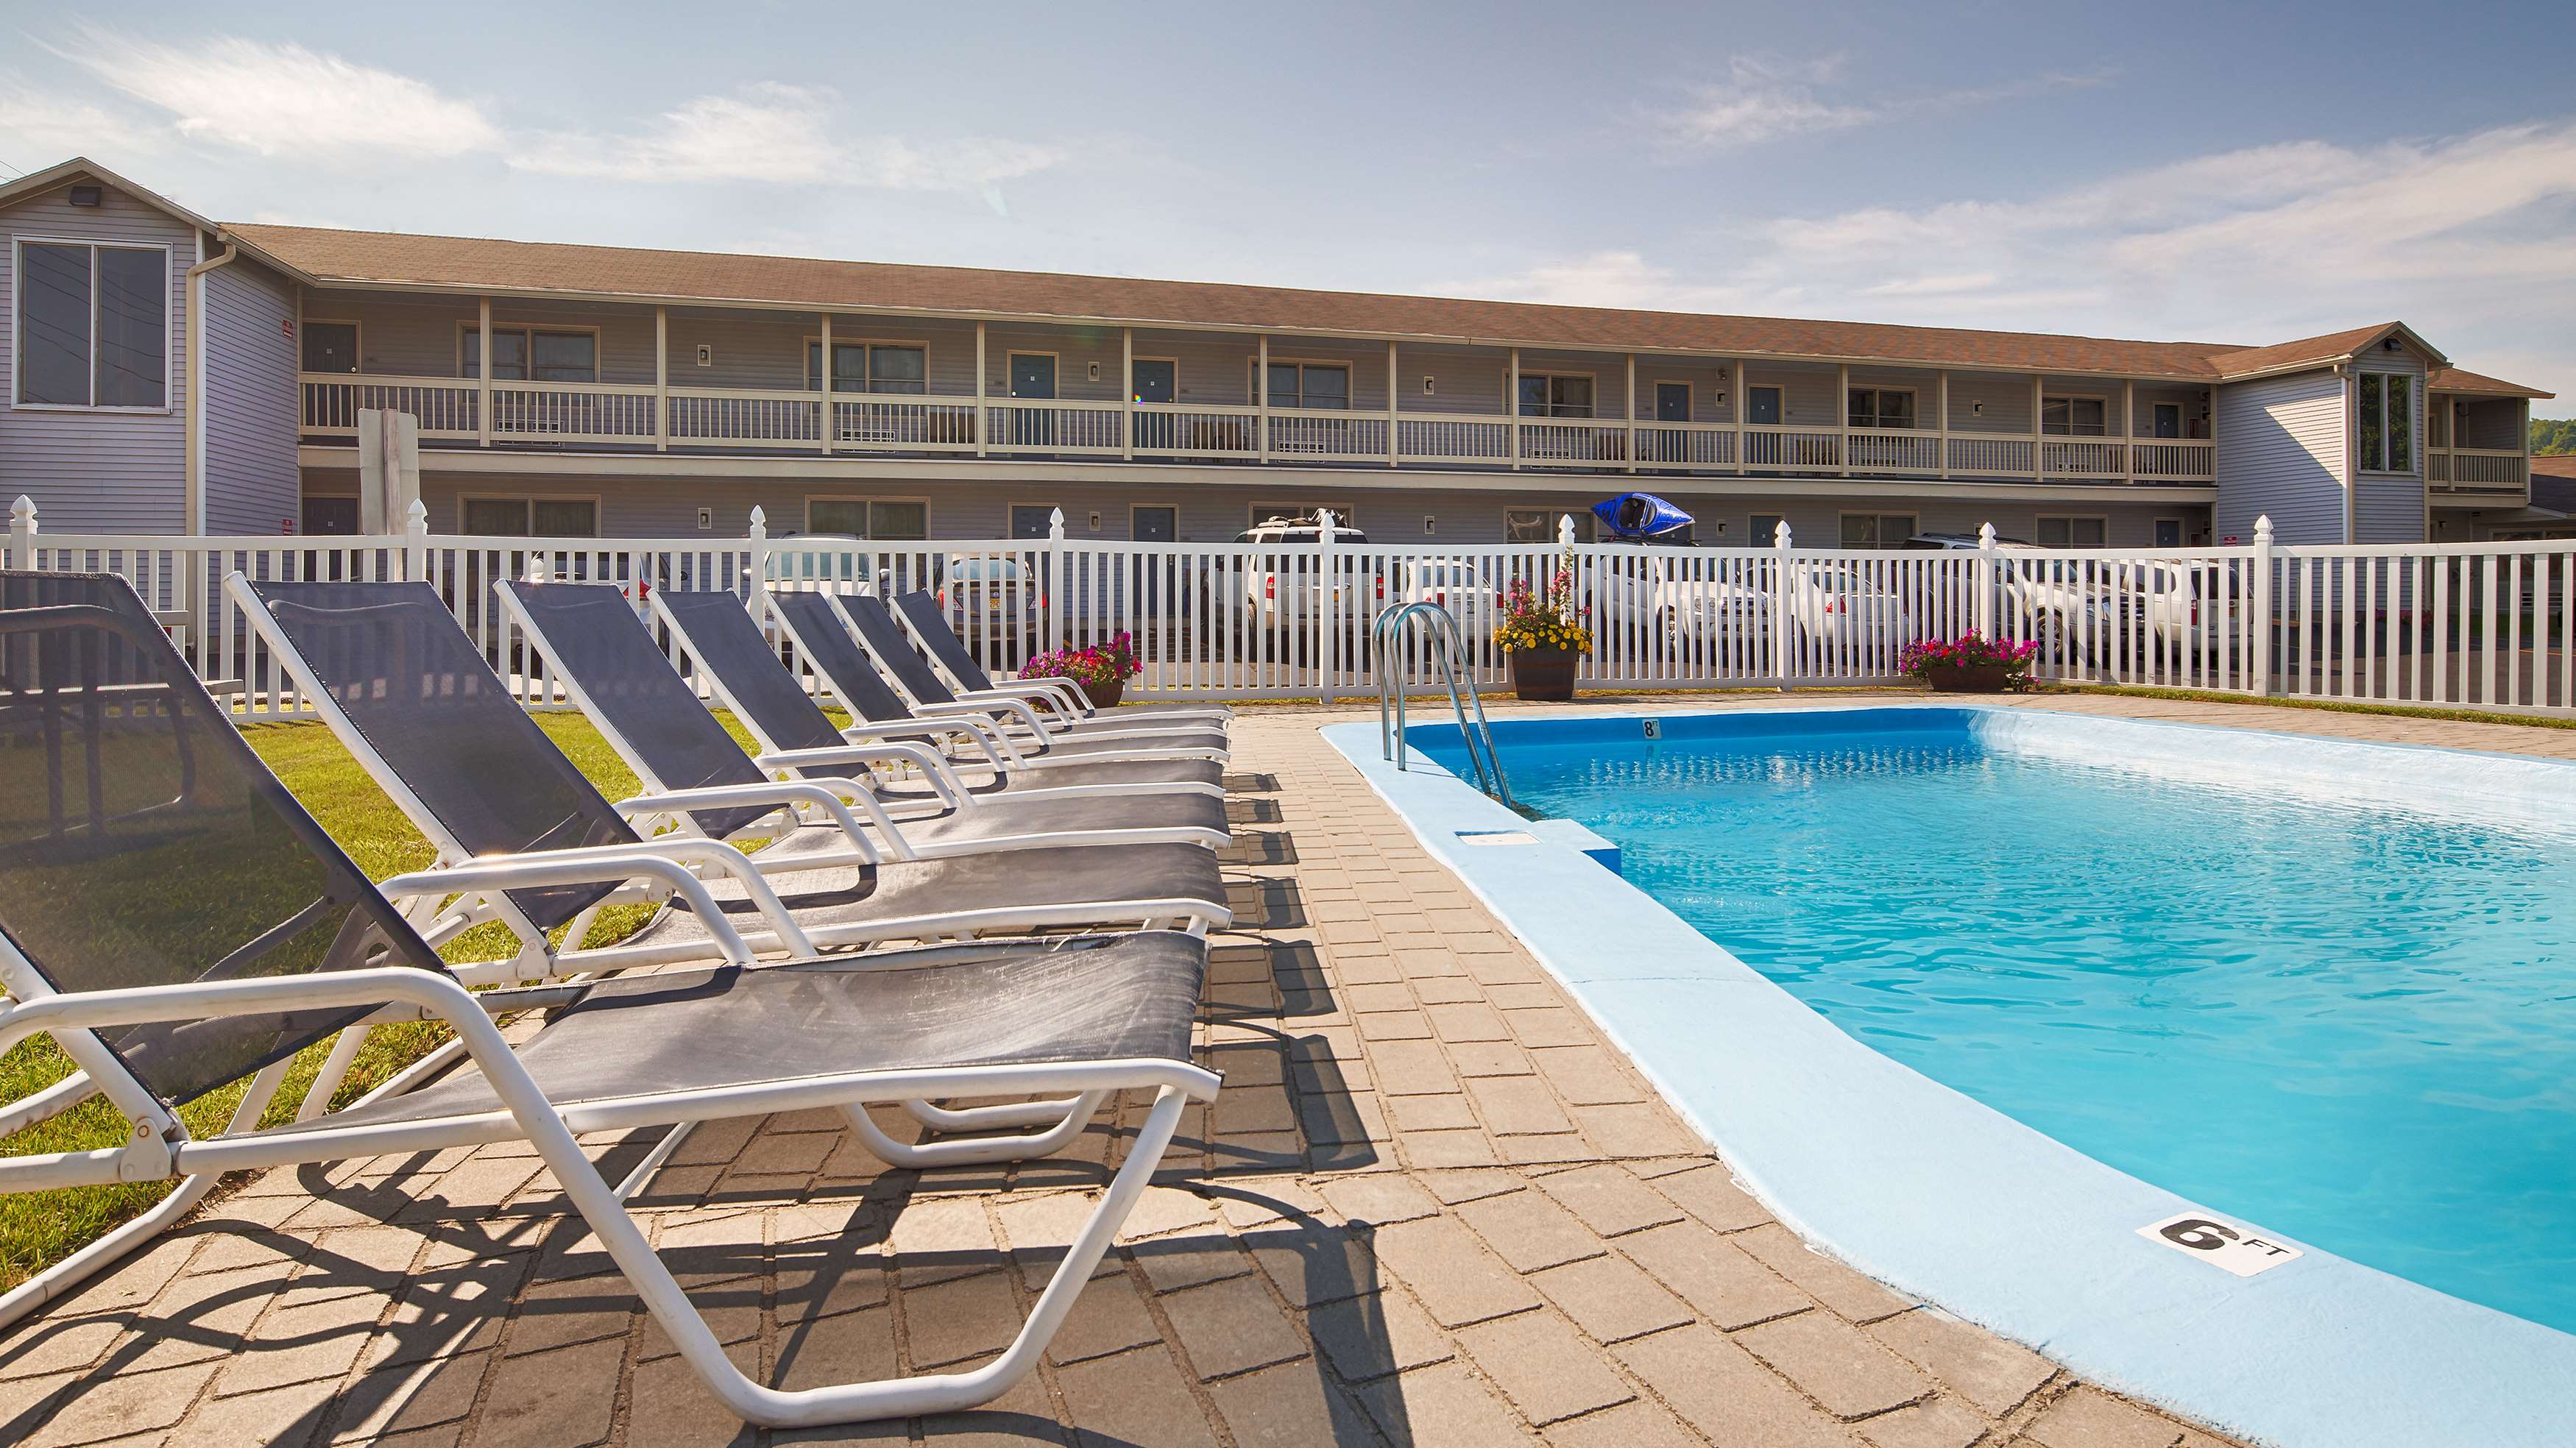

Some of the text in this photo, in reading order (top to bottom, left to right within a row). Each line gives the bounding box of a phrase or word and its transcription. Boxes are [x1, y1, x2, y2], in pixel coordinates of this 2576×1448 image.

[1644, 721, 1654, 737] 8
[2159, 1219, 2291, 1256] 6 FT
